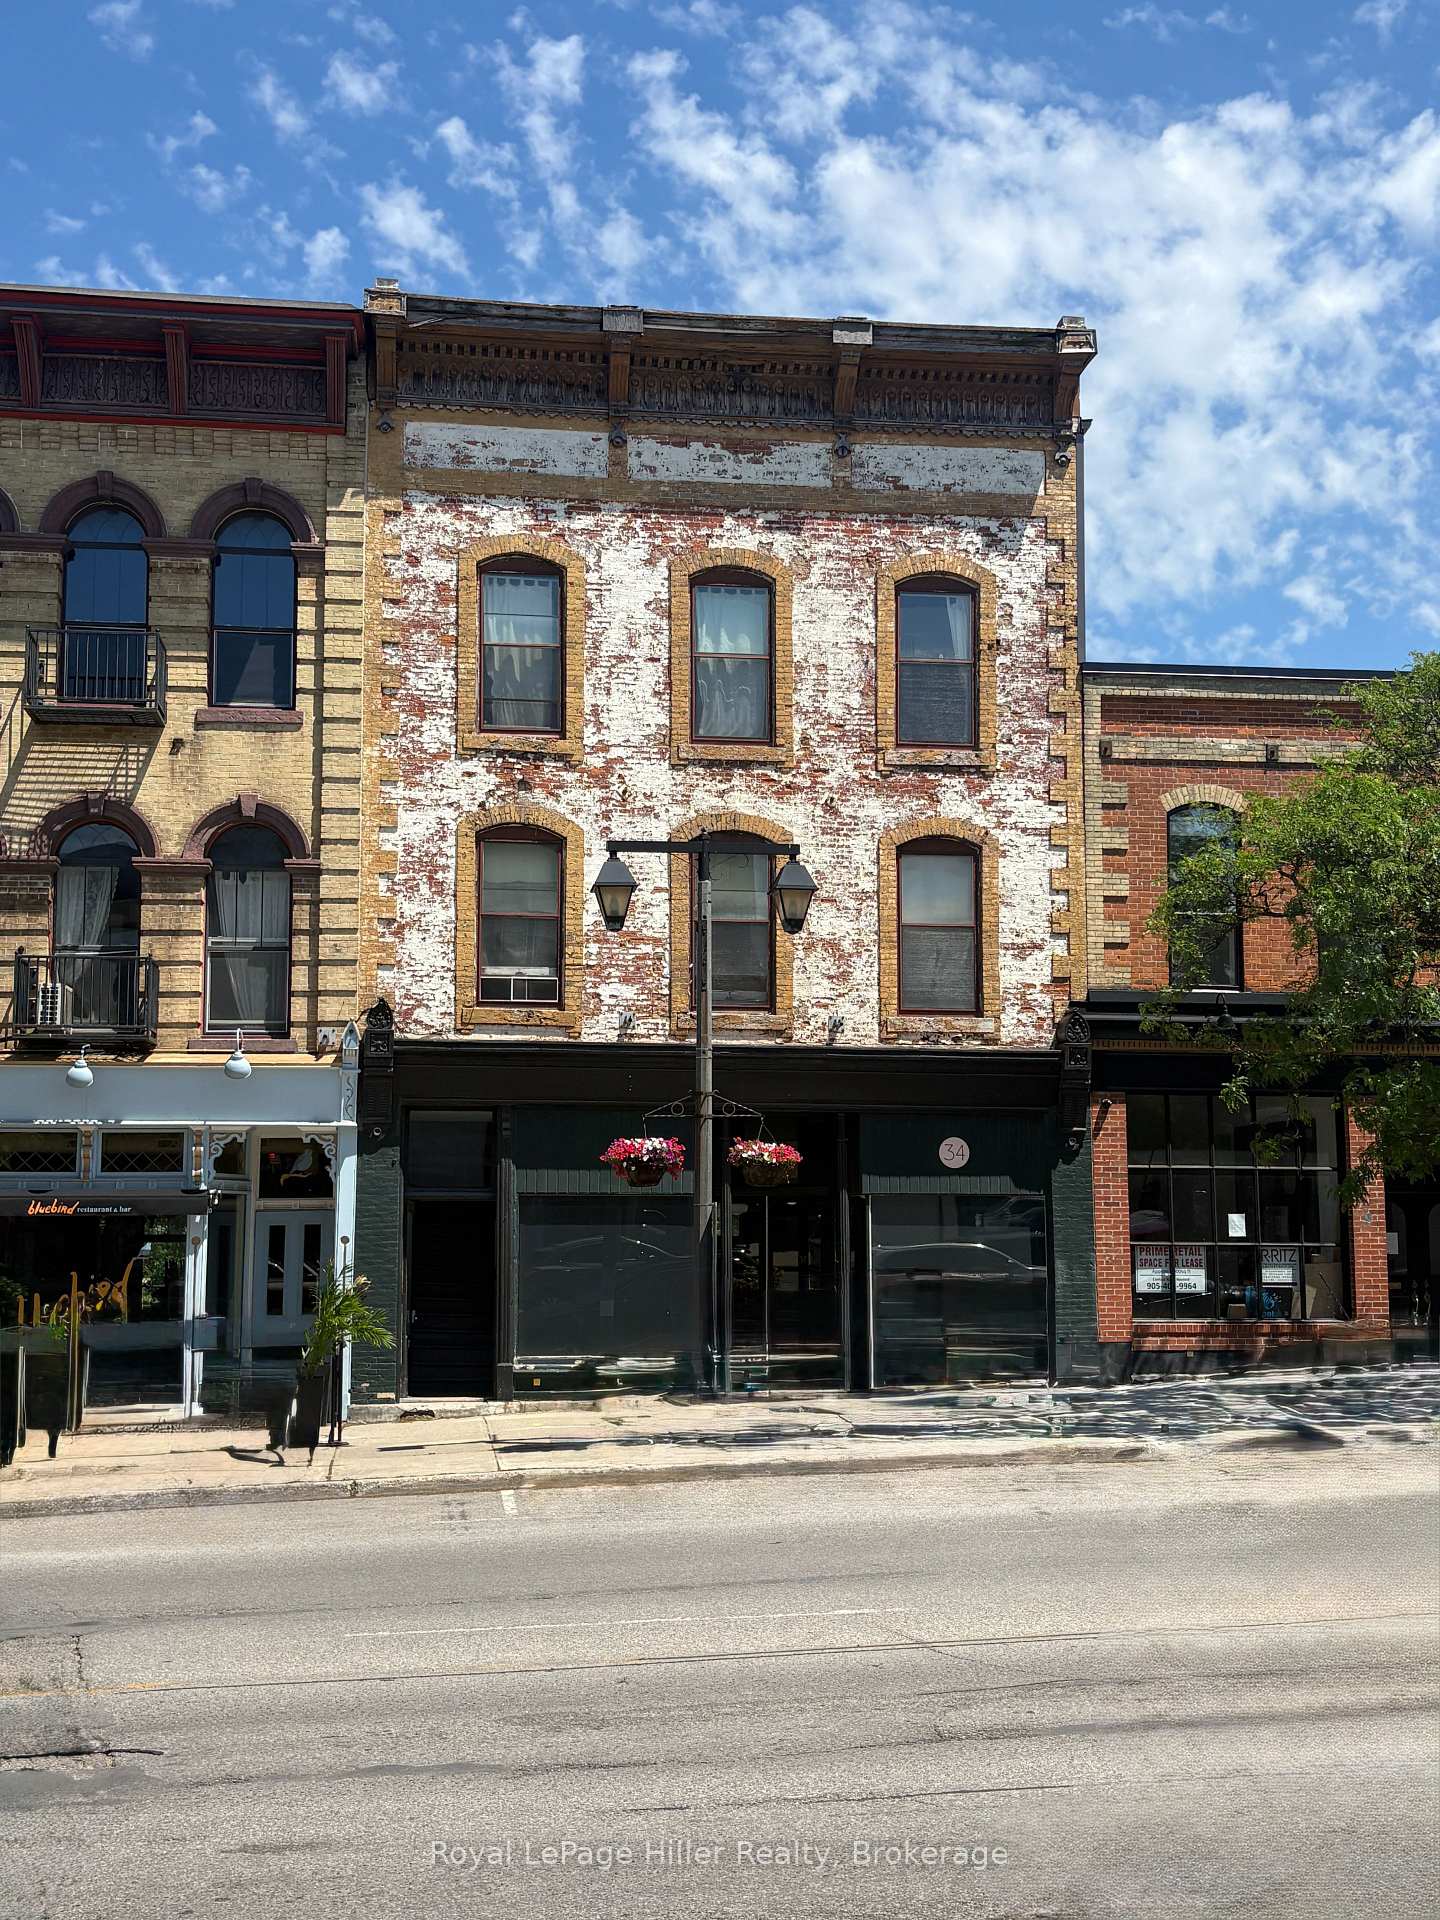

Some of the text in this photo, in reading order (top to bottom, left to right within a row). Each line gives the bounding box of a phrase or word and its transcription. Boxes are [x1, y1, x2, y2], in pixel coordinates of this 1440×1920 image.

[944, 1143, 966, 1161] 34
[27, 1198, 80, 1216] bluebird
[119, 1205, 132, 1213] bar
[1139, 1246, 1169, 1256] PRIME
[1139, 1258, 1204, 1268] SPACE FR LEASE
